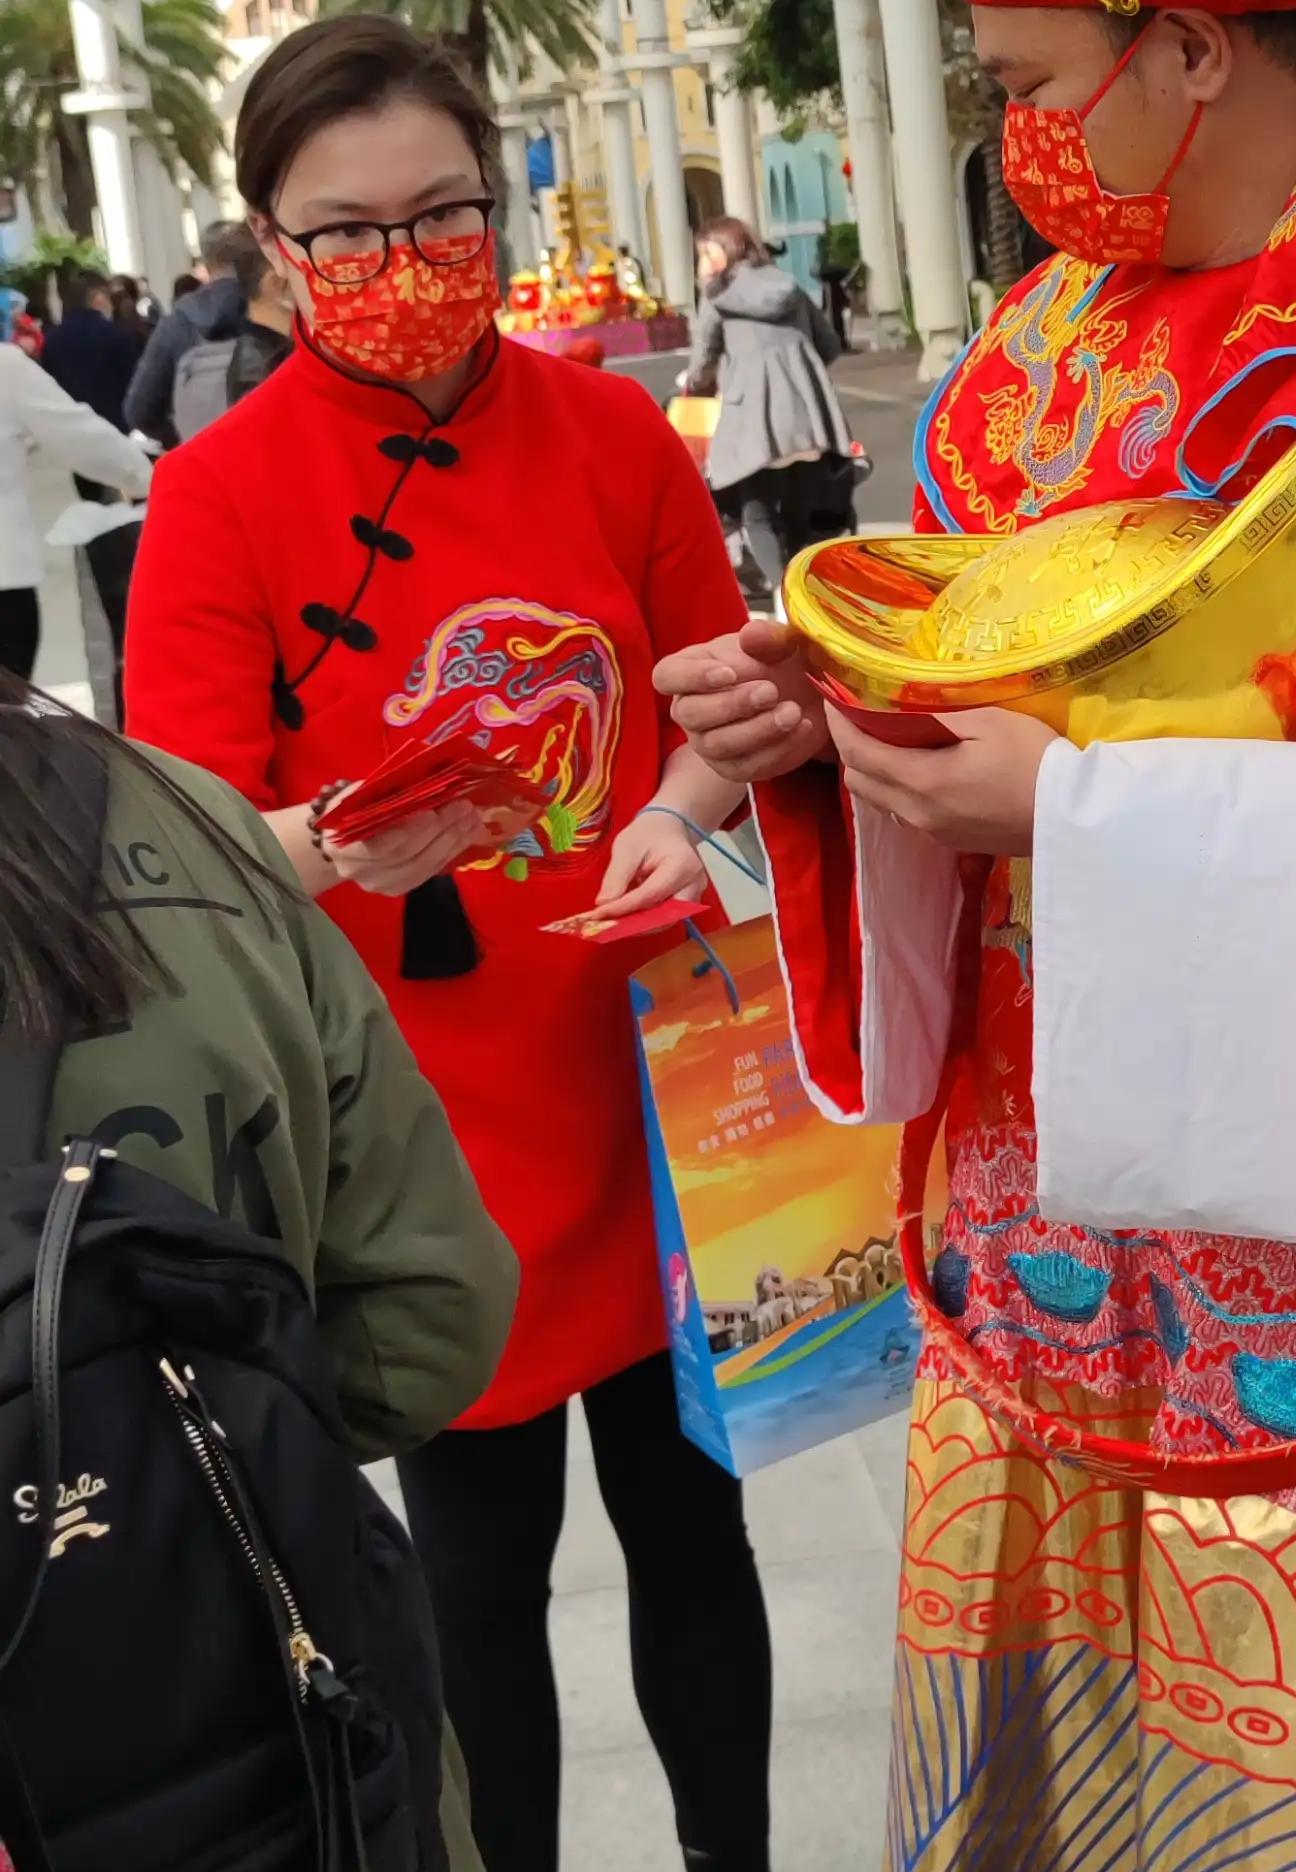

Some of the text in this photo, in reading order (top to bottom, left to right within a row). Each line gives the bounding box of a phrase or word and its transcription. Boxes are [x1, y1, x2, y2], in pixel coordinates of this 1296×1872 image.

[733, 1050, 759, 1071] FUN
[732, 1071, 764, 1096] FOOD
[713, 1090, 770, 1126] SHOPPING
